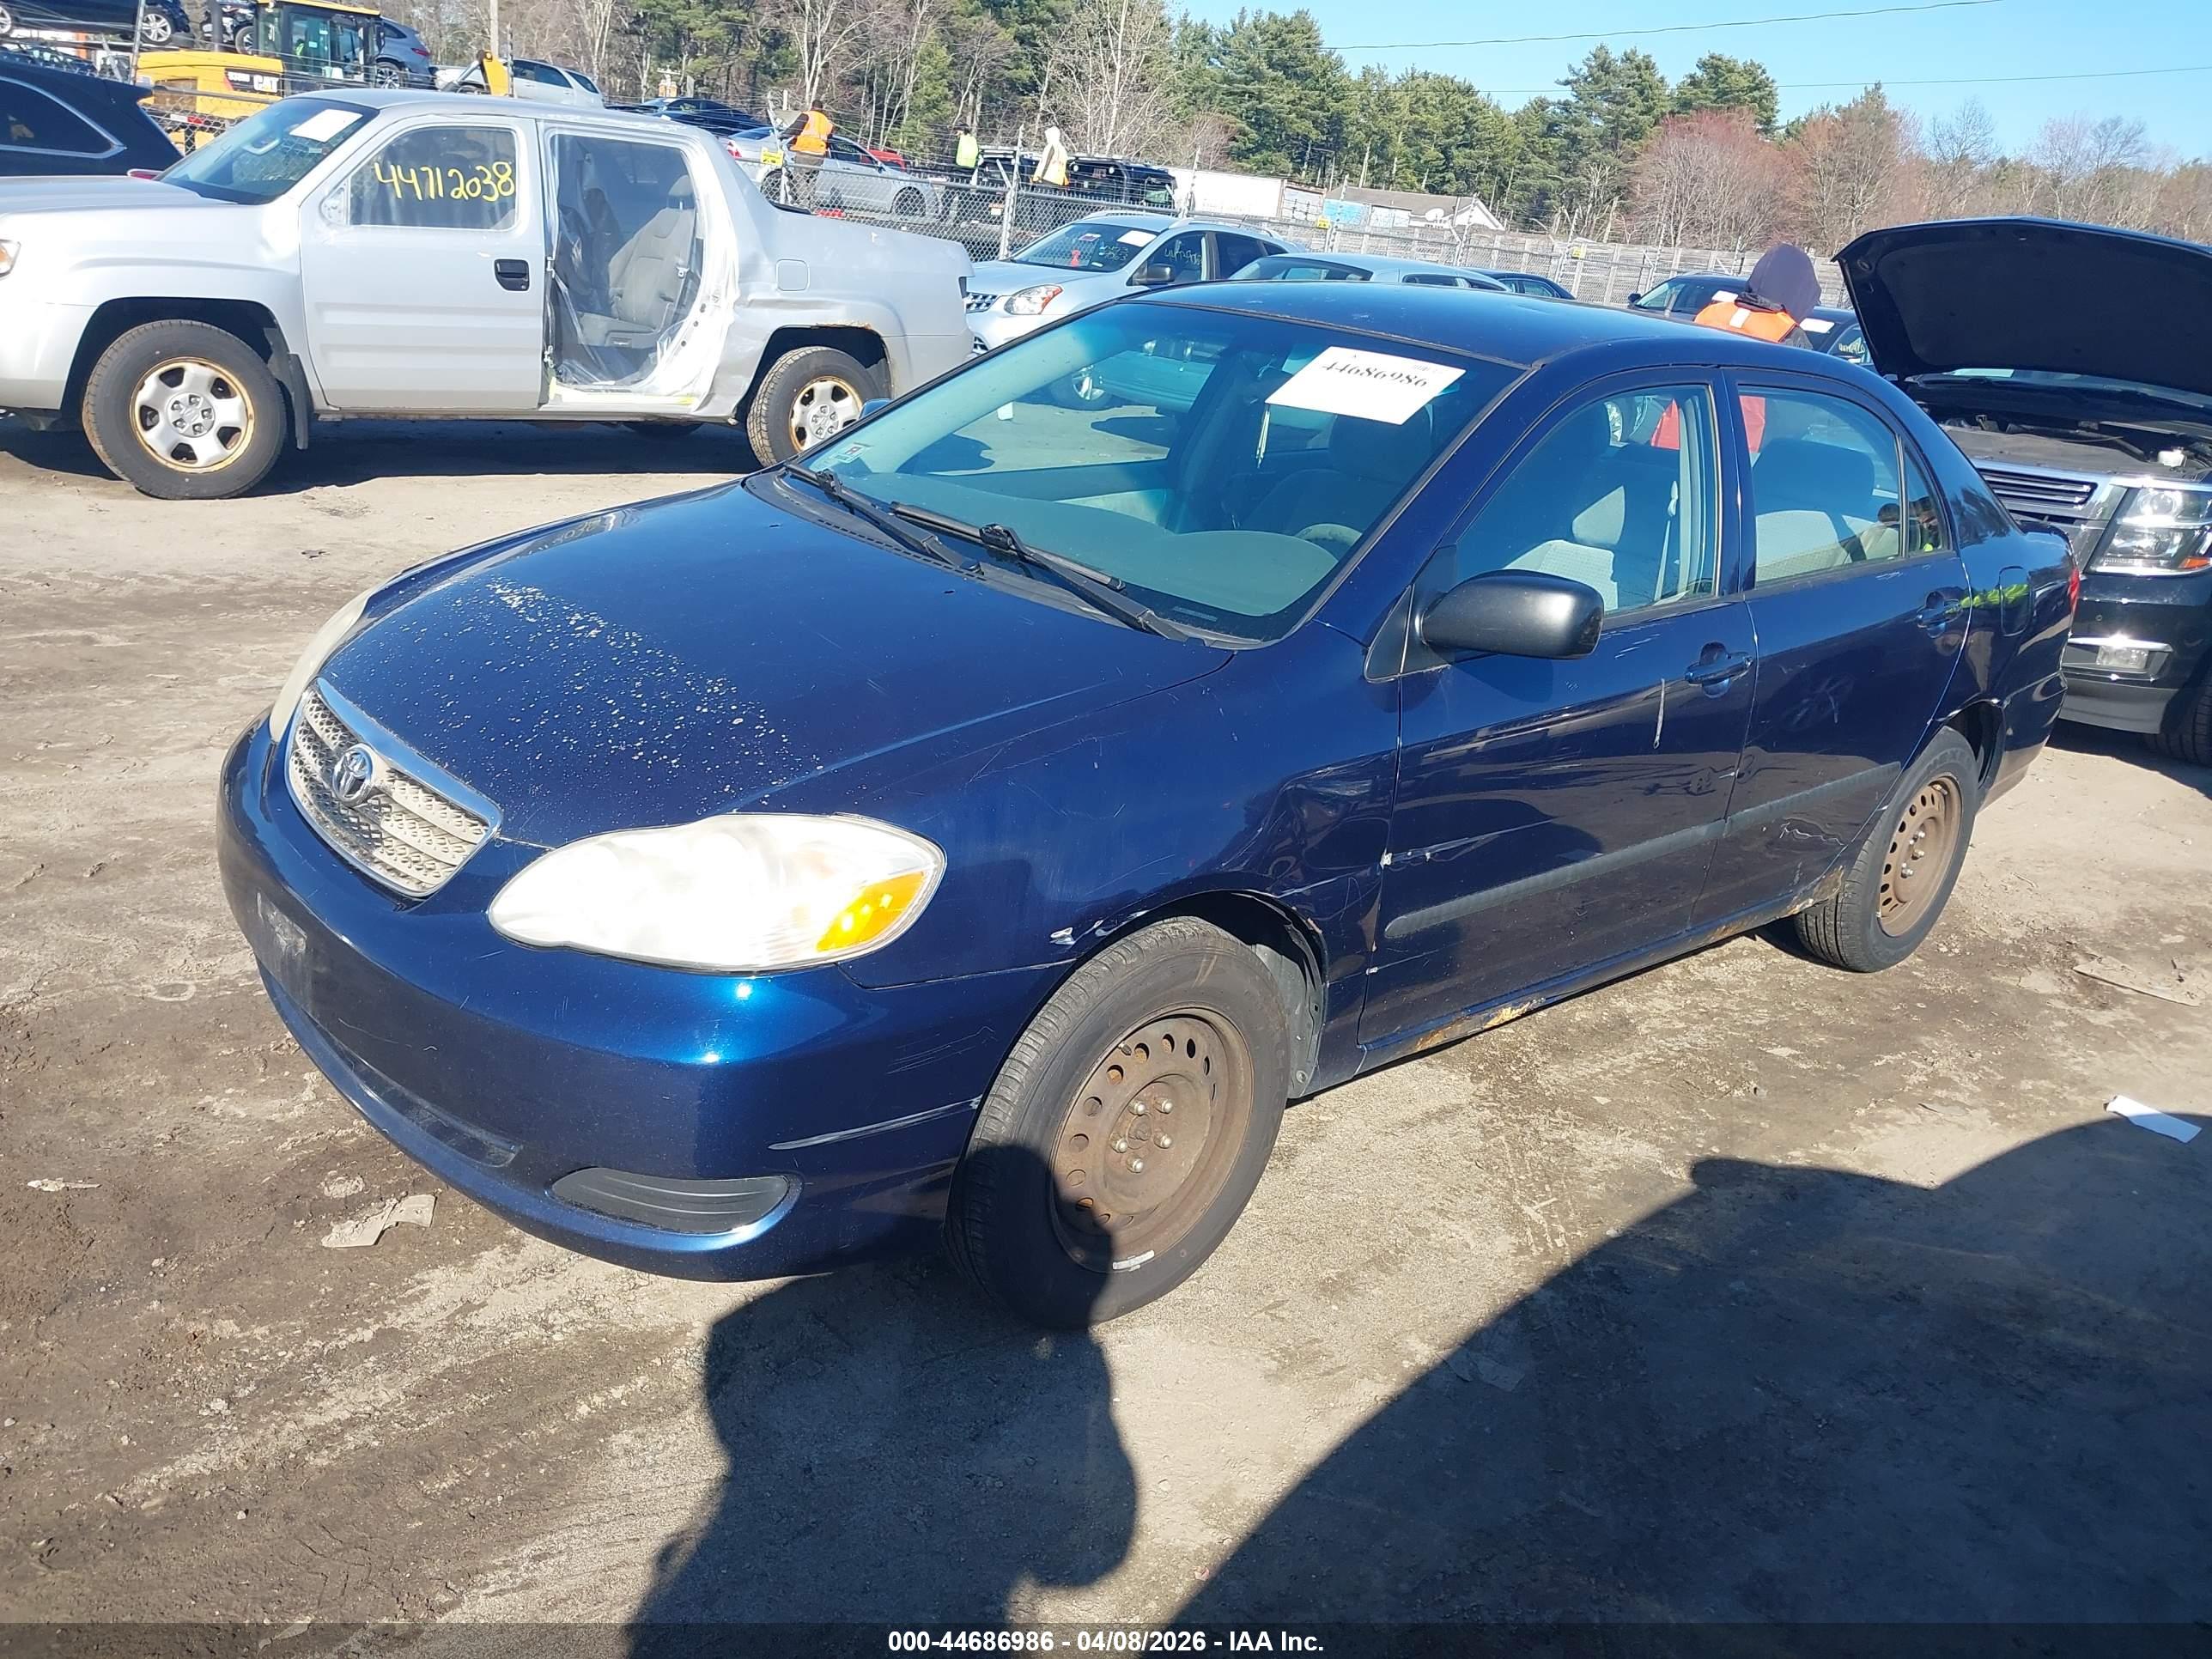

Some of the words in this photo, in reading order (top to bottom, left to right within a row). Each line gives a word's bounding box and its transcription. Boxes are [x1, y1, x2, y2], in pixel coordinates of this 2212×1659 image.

[253, 75, 279, 93] CAT
[373, 161, 515, 203] 44712038
[1322, 361, 1428, 386] 44686986
